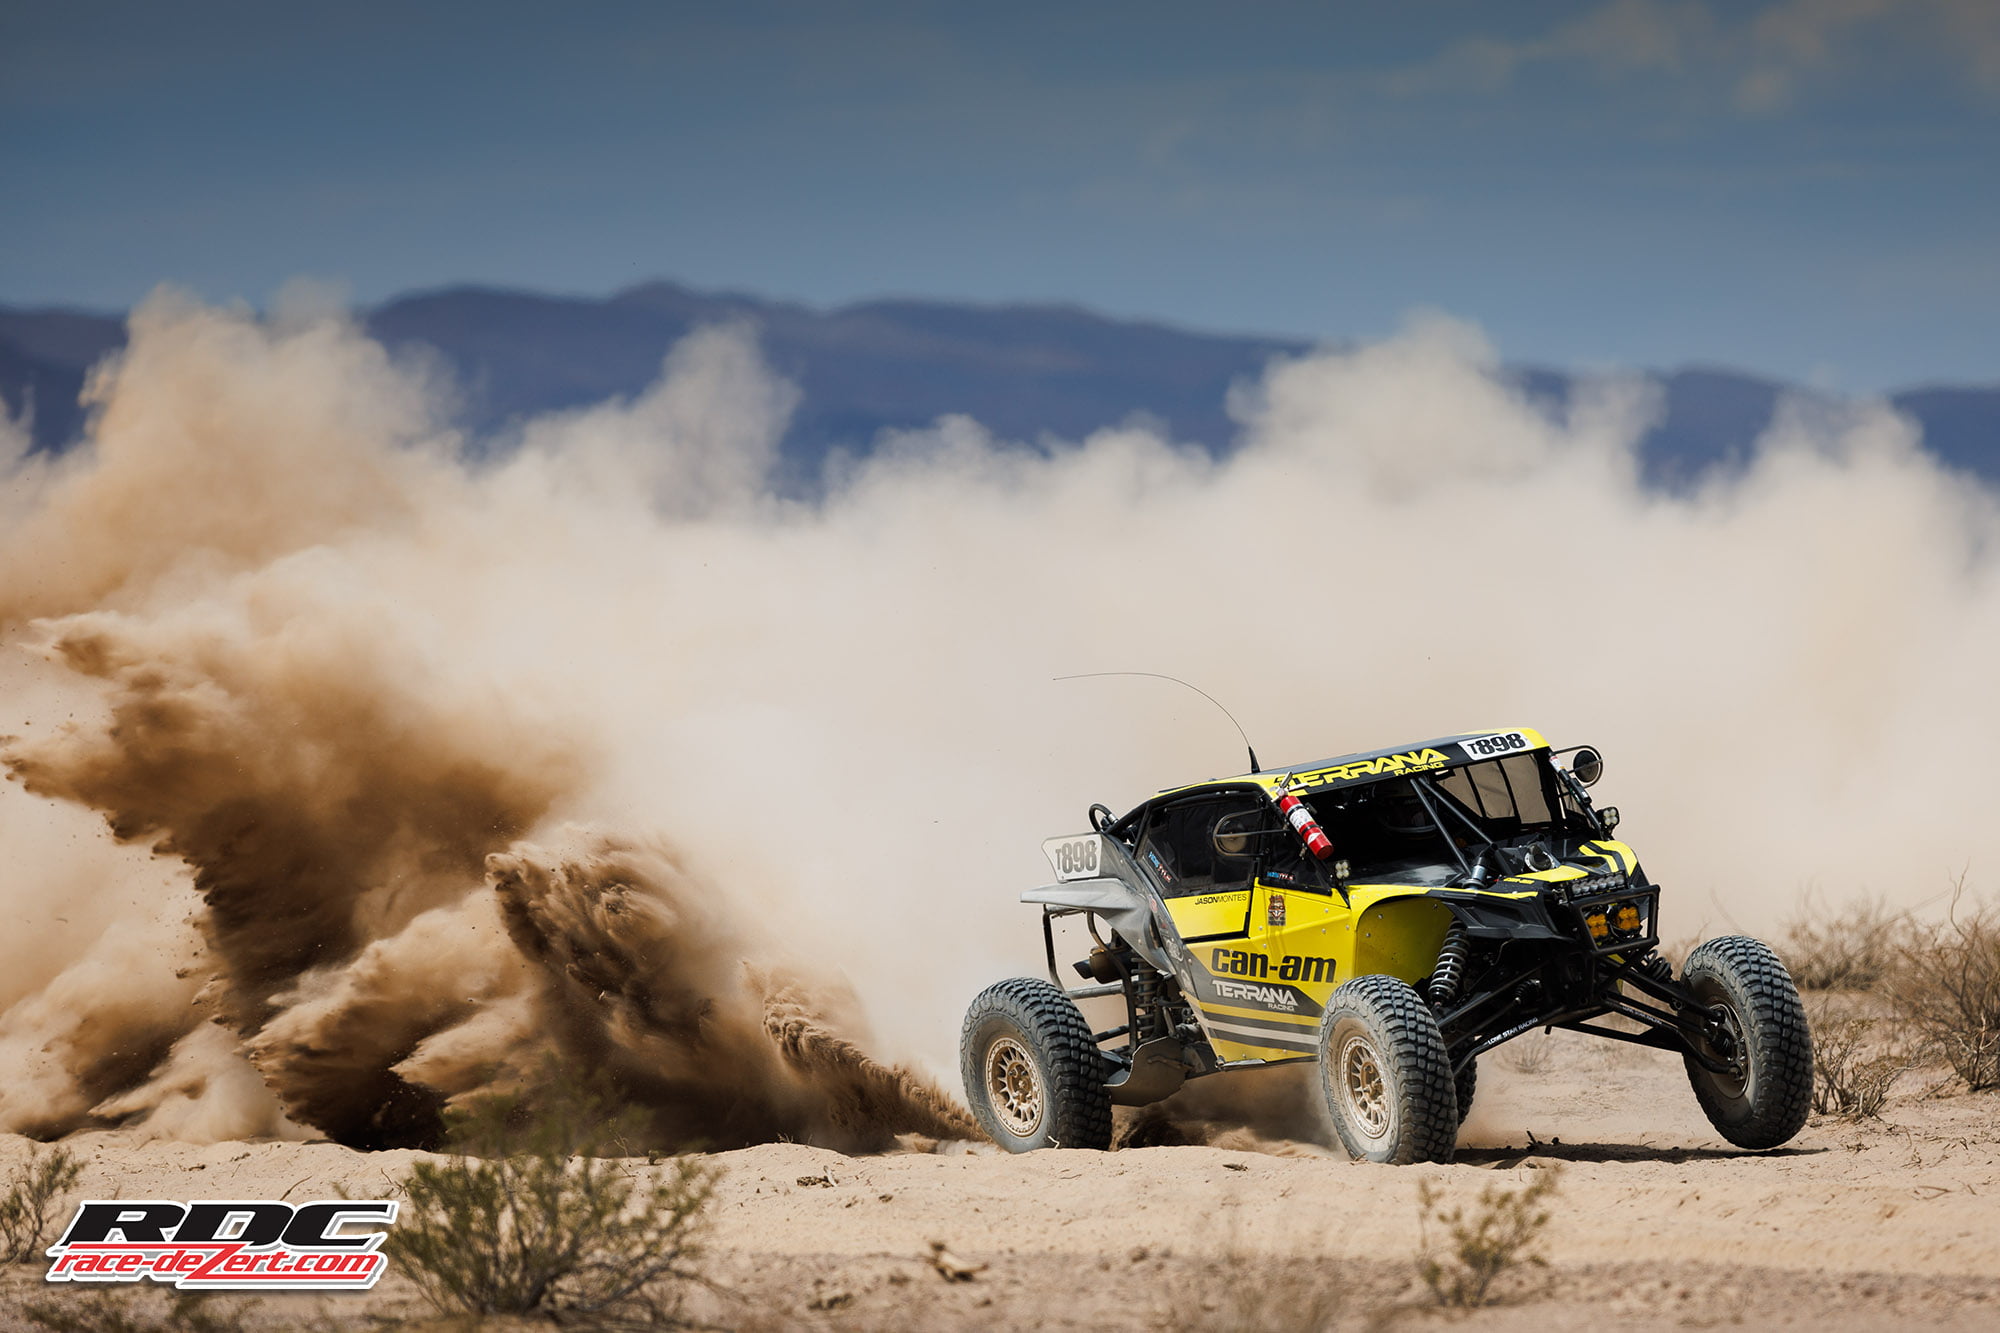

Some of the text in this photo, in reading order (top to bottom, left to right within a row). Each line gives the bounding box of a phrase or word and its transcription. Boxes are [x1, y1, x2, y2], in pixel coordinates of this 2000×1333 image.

[1467, 733, 1526, 754] T898
[1394, 762, 1445, 776] RACING
[1055, 840, 1097, 874] T898
[1211, 948, 1337, 983] can-am
[1212, 979, 1299, 1006] TERRANA
[1268, 1003, 1295, 1012] RACING
